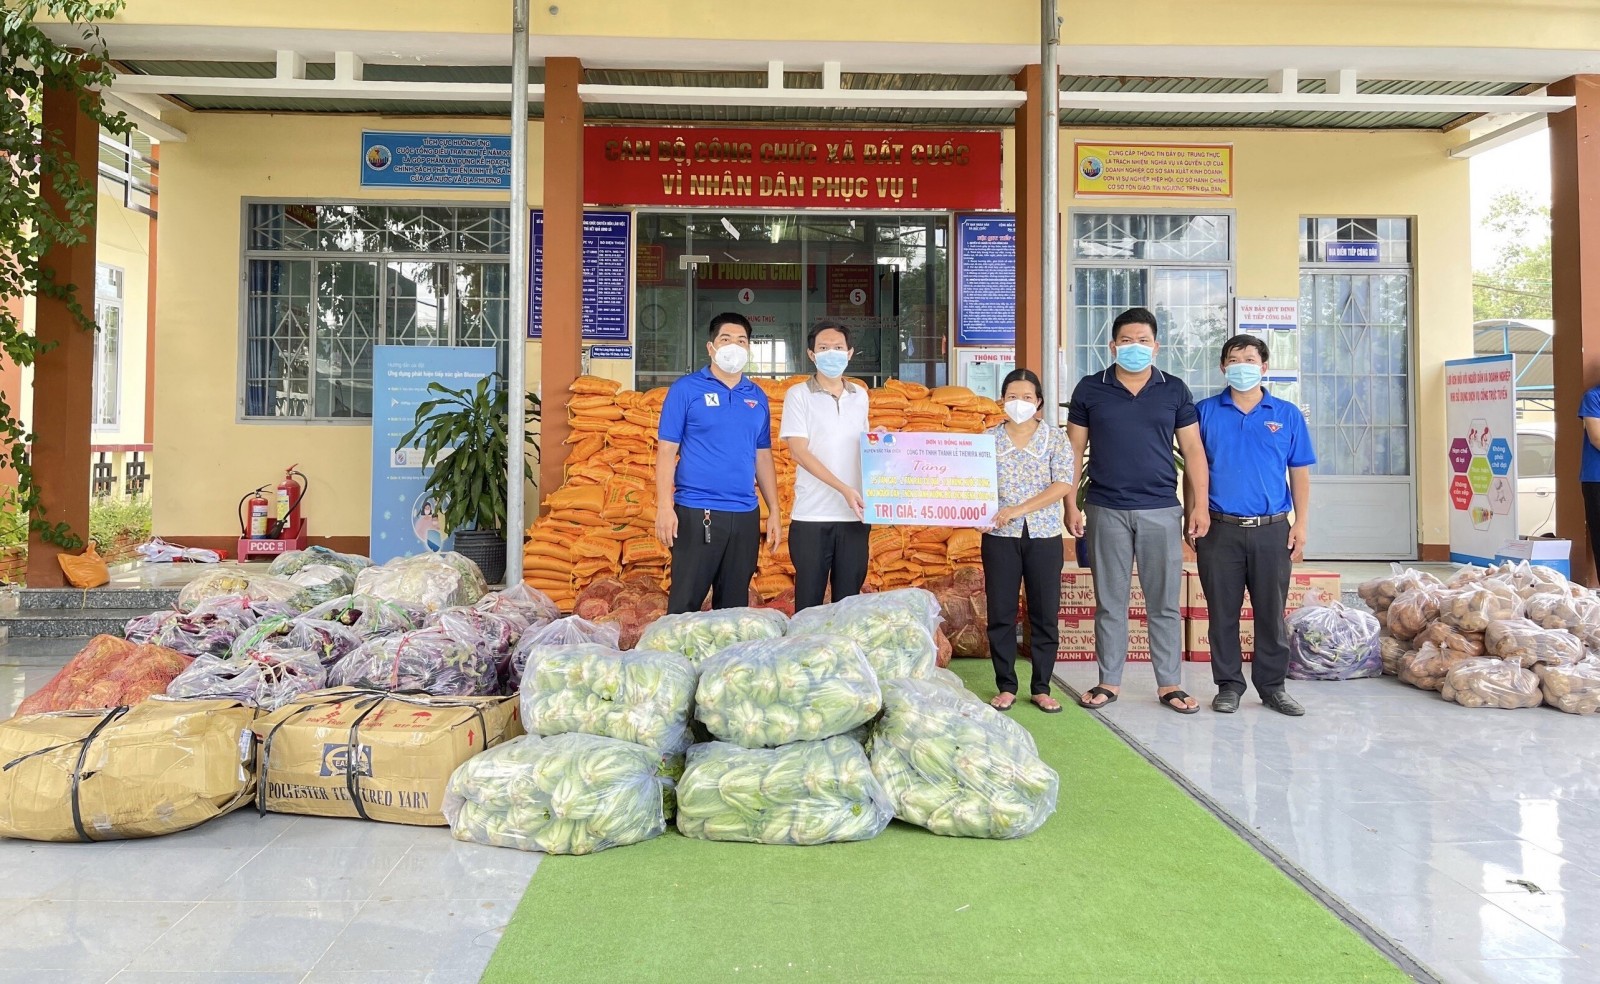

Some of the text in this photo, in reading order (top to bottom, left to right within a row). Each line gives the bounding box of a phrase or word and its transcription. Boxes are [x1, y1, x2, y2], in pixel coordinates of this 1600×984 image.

[606, 136, 651, 161] CÁN
[760, 139, 817, 164] CHỨC
[826, 140, 855, 165] XÃ
[863, 137, 904, 165] ĐẤT
[911, 138, 969, 166] CUỐC
[662, 169, 682, 195] VÌ
[690, 170, 752, 196] NHÂN
[759, 171, 804, 197] DÂN
[812, 176, 868, 202] PHỤC
[876, 177, 905, 203] VỤ
[743, 291, 750, 301] 4
[855, 291, 861, 302] 5
[975, 353, 998, 361] THÔNG
[874, 504, 893, 521] TRỊ
[896, 502, 918, 519] GIÁ:
[251, 542, 275, 551] PCCC
[1077, 588, 1096, 602] VIỆ
[1130, 608, 1148, 616] THA
[1080, 633, 1096, 647] VIỆ
[1057, 652, 1082, 660] HANH
[1127, 652, 1151, 660] THAN
[267, 781, 430, 809] POLYESTER TEURED YARN
